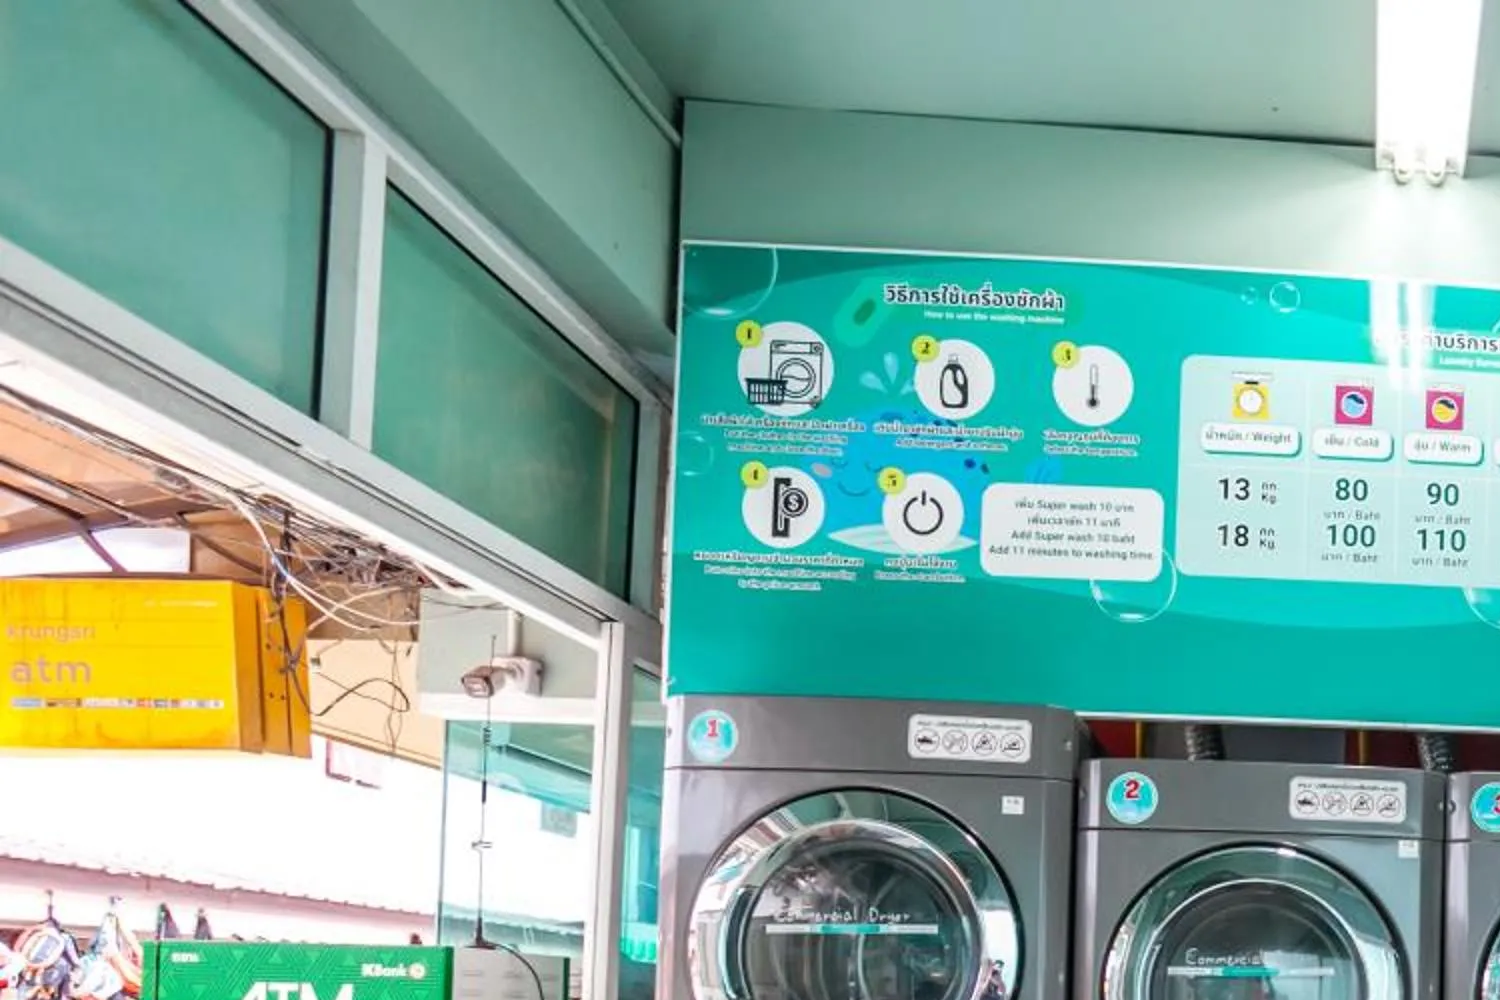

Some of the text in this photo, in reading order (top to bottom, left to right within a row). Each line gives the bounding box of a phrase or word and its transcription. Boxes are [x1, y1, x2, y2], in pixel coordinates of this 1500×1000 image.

[1253, 433, 1291, 445] Weight
[1354, 437, 1380, 447] Cold
[1439, 440, 1471, 452] Warm
[1218, 478, 1251, 501] 13
[1261, 492, 1277, 505] Kg
[1335, 478, 1369, 501] 80
[1426, 483, 1460, 506] 90
[1037, 500, 1066, 511] Super
[1035, 531, 1065, 542] Super
[1217, 524, 1249, 547] 18
[1259, 539, 1275, 550] Kg
[1327, 524, 1376, 547] 100
[1416, 529, 1467, 552] 110
[1071, 548, 1083, 557] to
[11, 655, 91, 684] atm
[706, 719, 719, 738] 1
[1125, 780, 1141, 799] 2
[868, 907, 911, 927] Dryer
[361, 963, 406, 979] KBank
